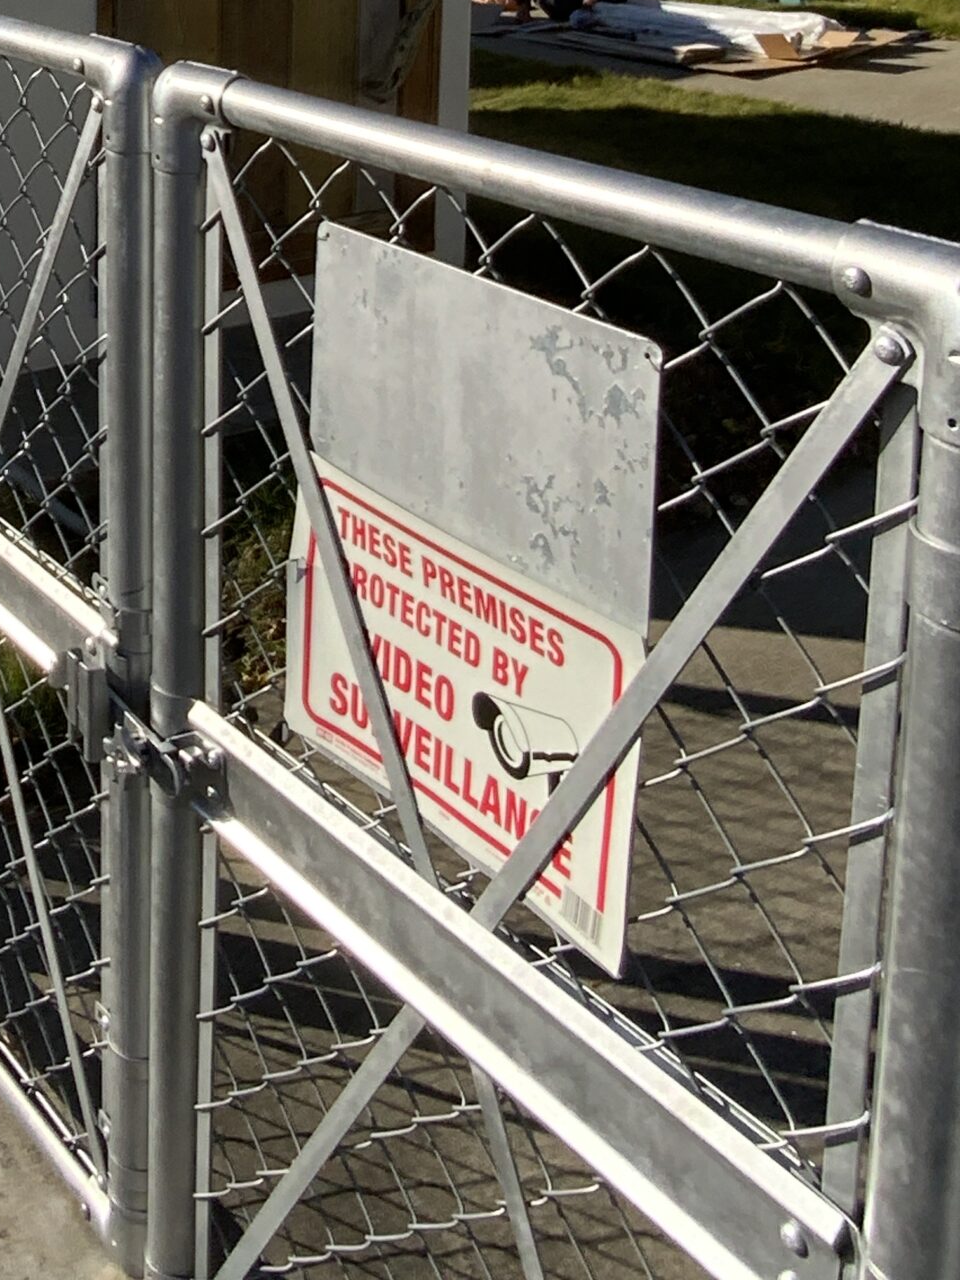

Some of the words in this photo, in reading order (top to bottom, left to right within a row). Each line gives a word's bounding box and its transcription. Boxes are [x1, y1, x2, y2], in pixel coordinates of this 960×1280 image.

[337, 505, 413, 578] THESE
[421, 555, 566, 667] PREMISES
[492, 646, 530, 698] BY
[329, 672, 573, 880] SUVEILLANE
